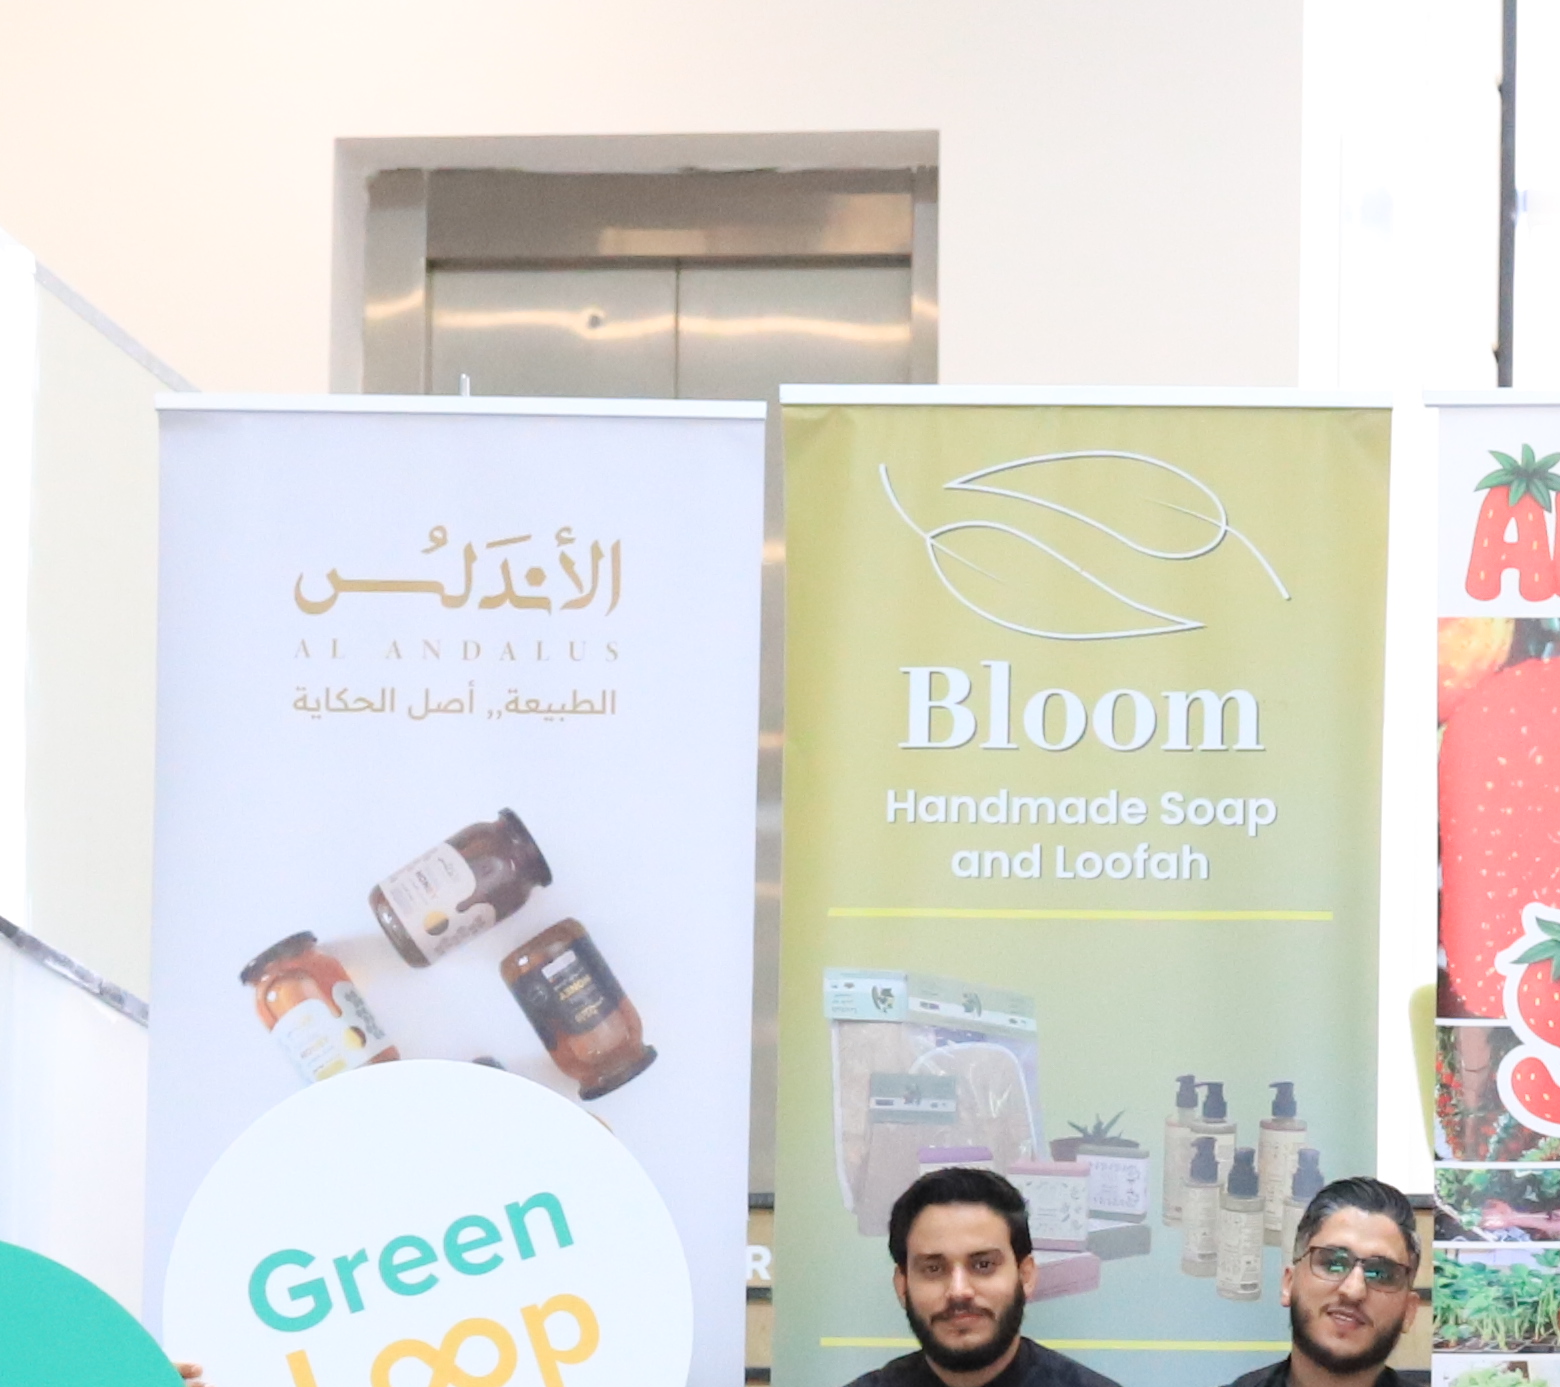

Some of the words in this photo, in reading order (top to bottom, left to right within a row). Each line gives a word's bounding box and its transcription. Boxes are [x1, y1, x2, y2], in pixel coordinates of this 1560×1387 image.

[294, 640, 346, 662] AL
[384, 640, 620, 663] ANDALUS
[293, 686, 396, 722] الحكاية
[408, 681, 476, 722] أصل
[898, 660, 1266, 752] Bloom
[886, 789, 1149, 826] Handmade
[1160, 791, 1277, 836] Soap
[951, 842, 1041, 879] and
[1055, 842, 1210, 880] Loofah
[247, 1191, 575, 1334] Green
